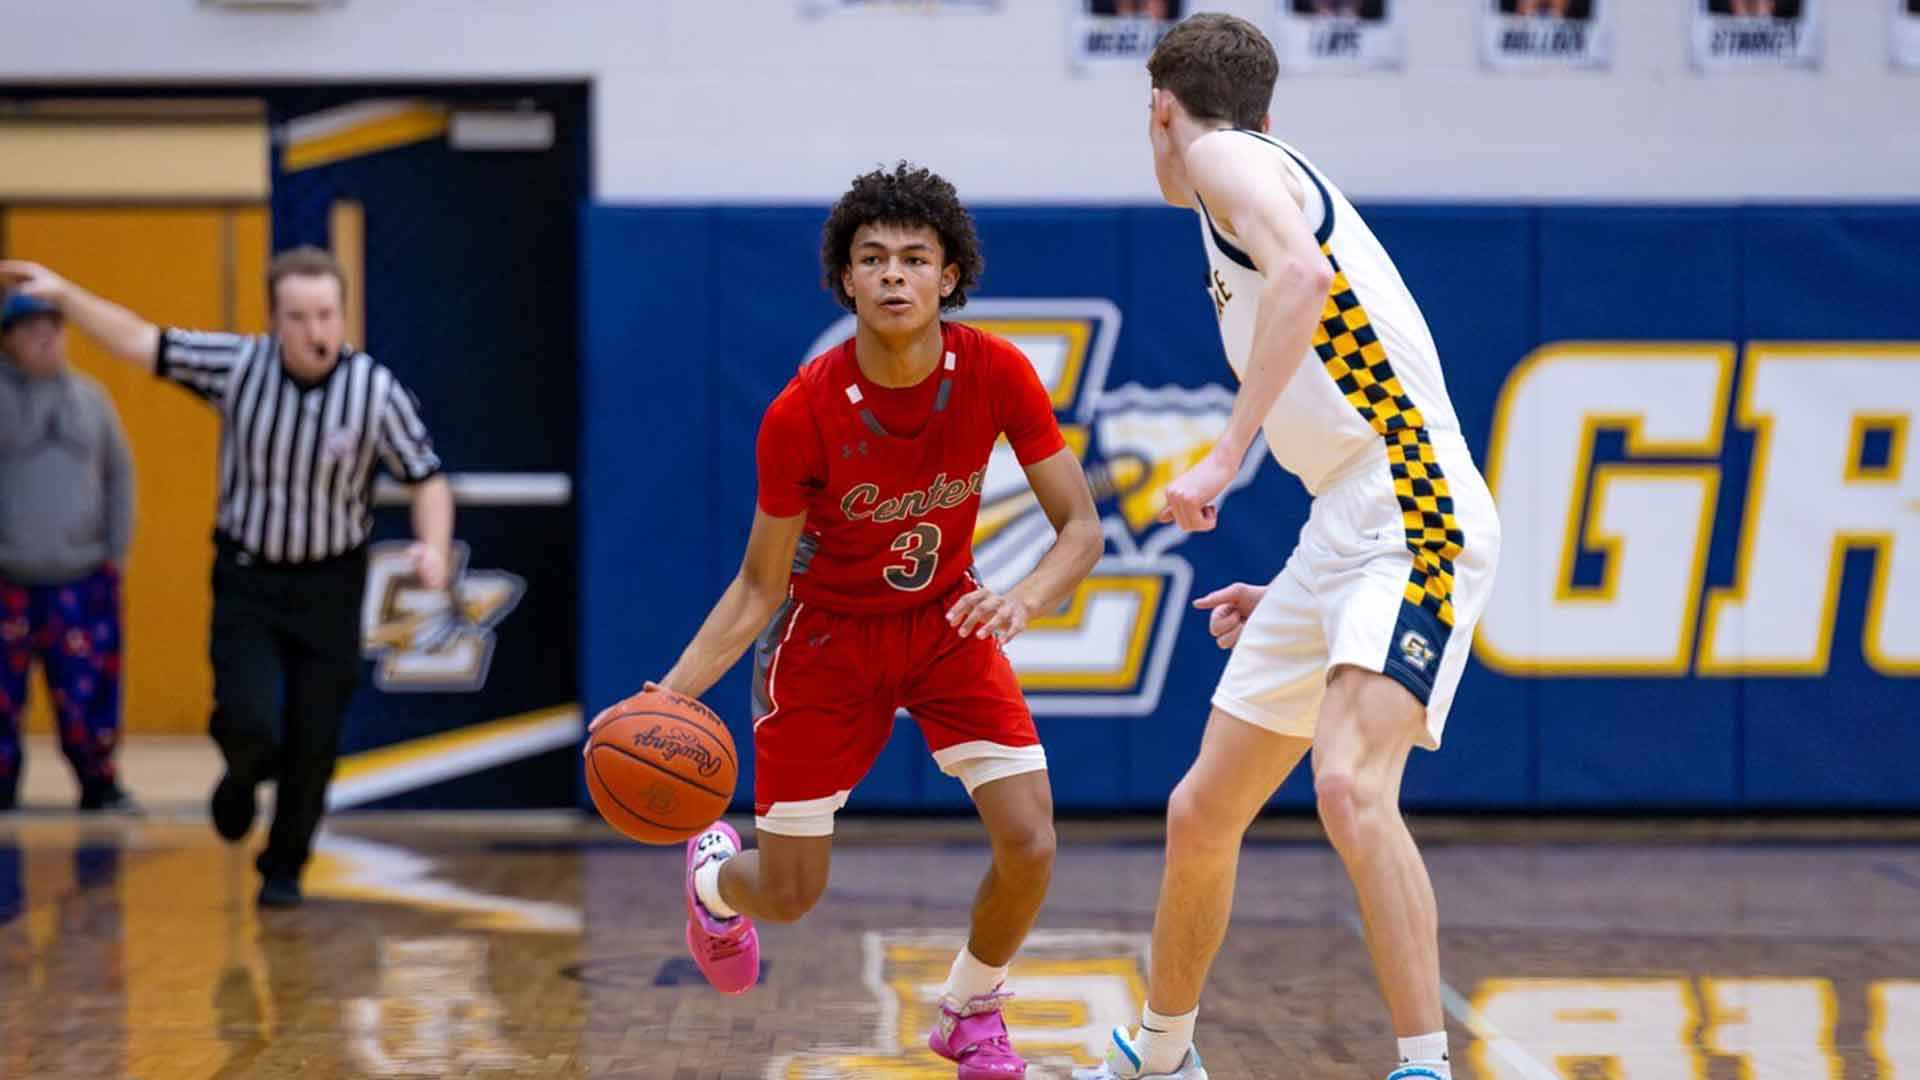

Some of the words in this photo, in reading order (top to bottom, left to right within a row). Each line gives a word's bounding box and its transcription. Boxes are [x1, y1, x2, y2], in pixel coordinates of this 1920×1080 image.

[840, 465, 987, 522] Center
[883, 521, 942, 592] 3
[633, 724, 722, 778] Rawlings
